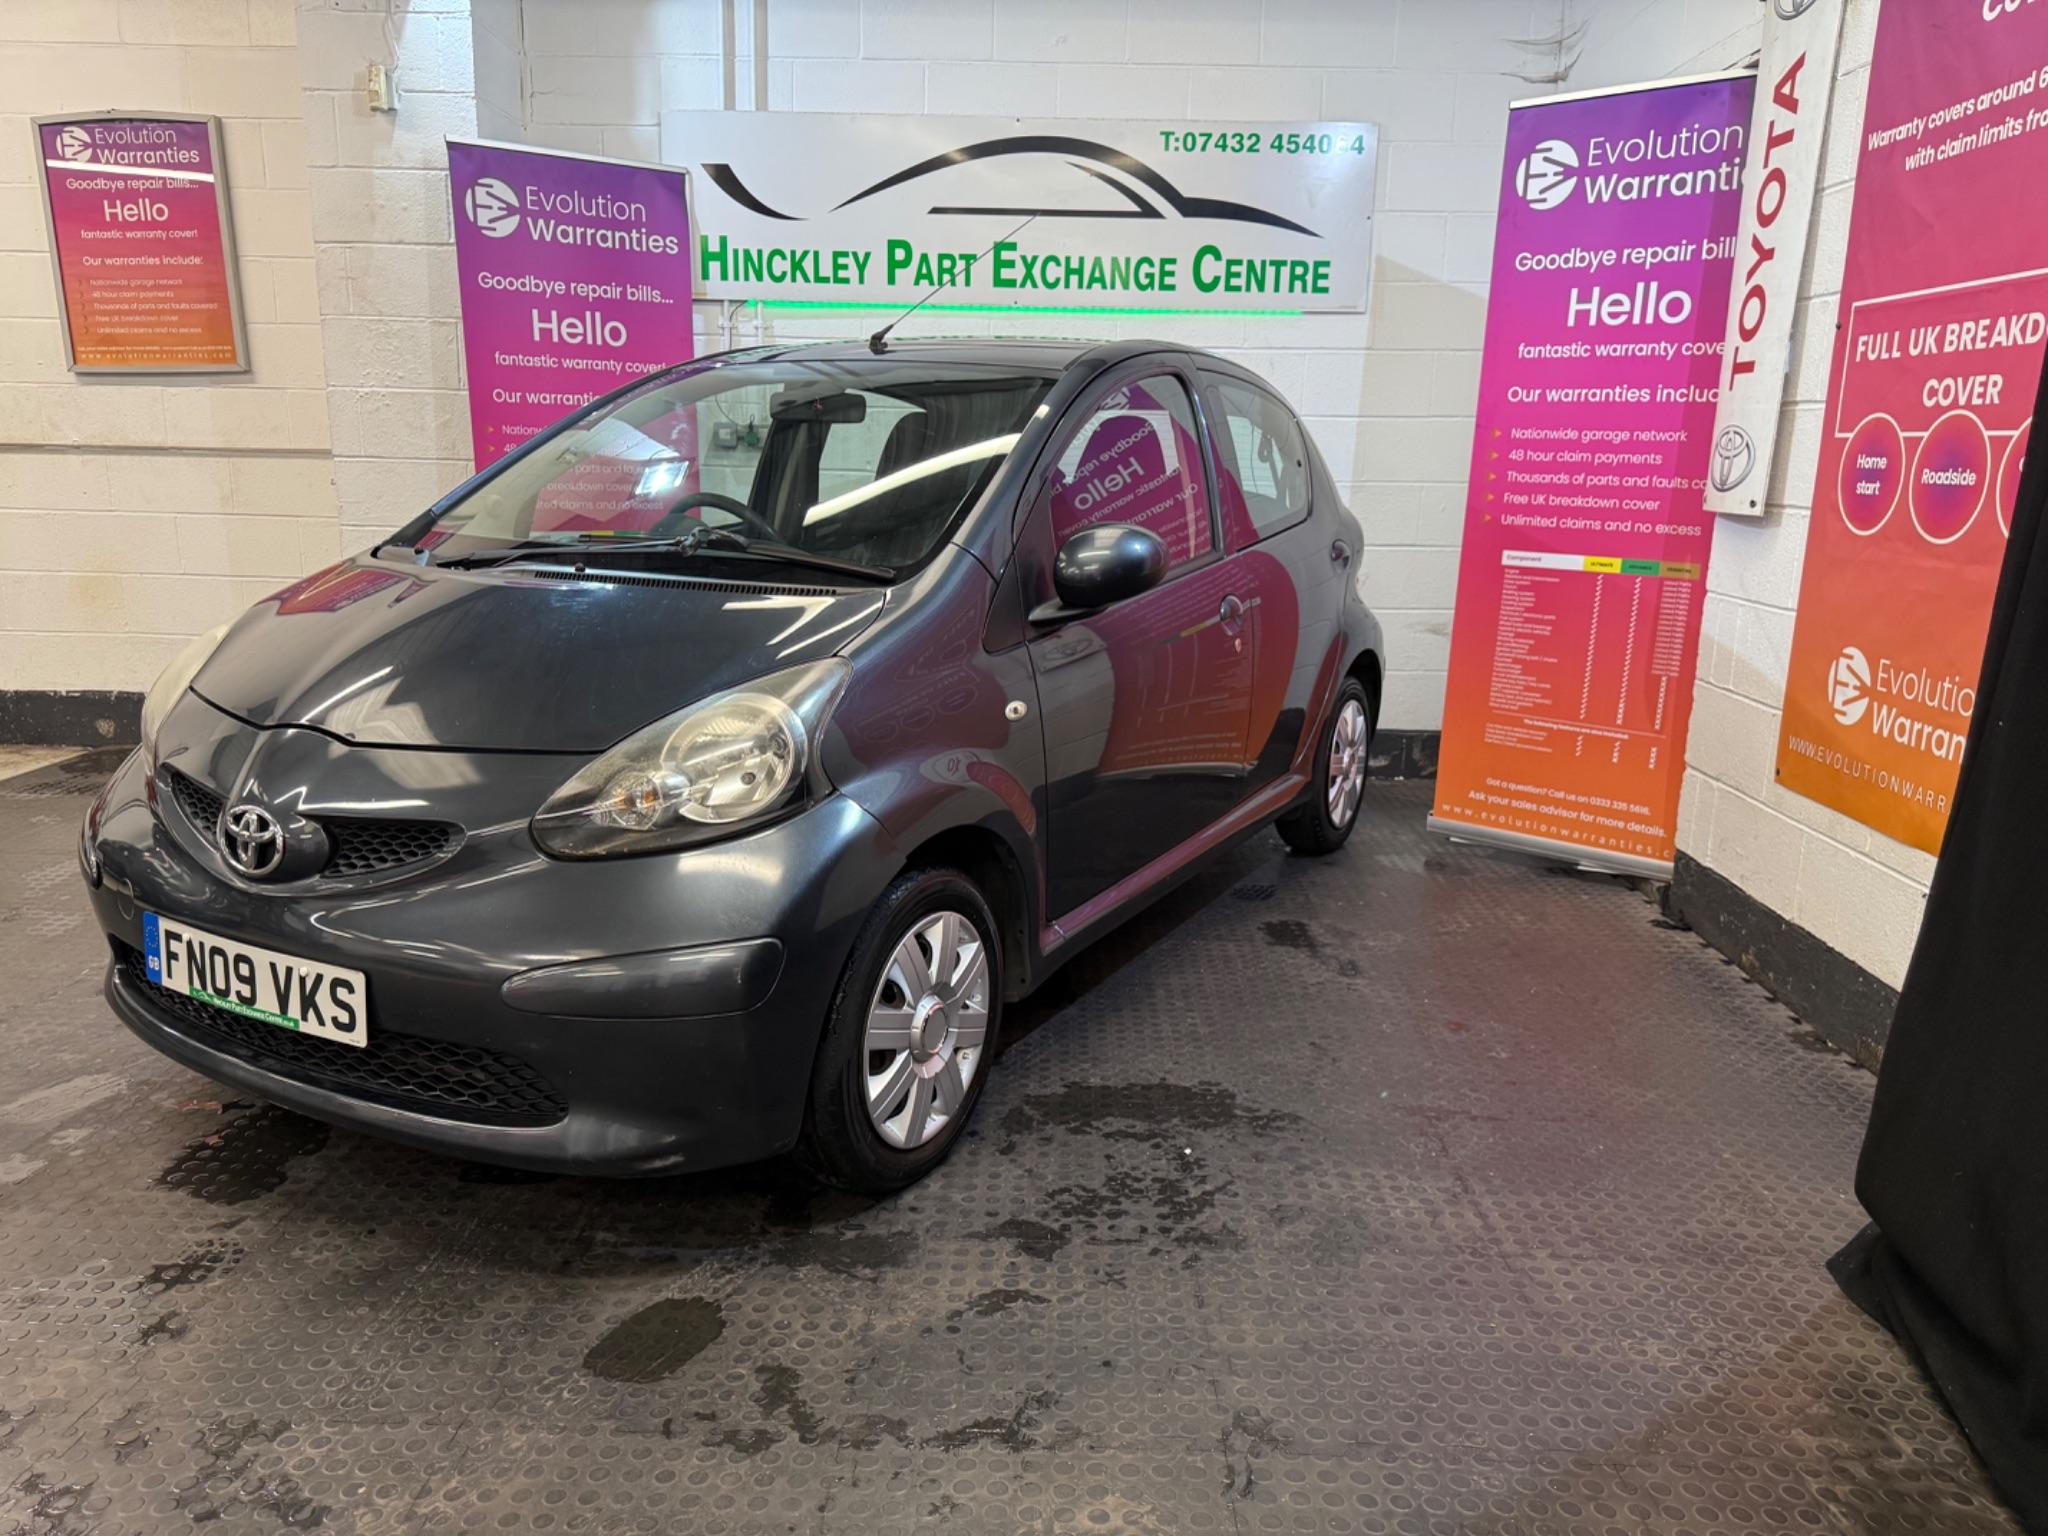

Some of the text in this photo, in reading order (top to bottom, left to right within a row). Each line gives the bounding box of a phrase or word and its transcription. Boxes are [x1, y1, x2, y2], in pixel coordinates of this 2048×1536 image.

[1868, 116, 1927, 151] Warranty
[1928, 98, 1975, 129] covers
[1976, 70, 2037, 111] around
[95, 128, 177, 144] Evolution
[1160, 131, 1261, 153] T:07432
[1588, 122, 1744, 167] Evolution
[1905, 145, 1936, 171] with
[1937, 133, 1977, 161] claim
[1978, 117, 2024, 148] limits
[97, 147, 200, 164] Warranties
[66, 178, 125, 192] Goodbye
[127, 178, 164, 192] repair
[1584, 157, 1742, 204] Warranti
[103, 198, 169, 222] Hello
[526, 186, 647, 222] Evolution
[1729, 51, 1806, 391] TOYOTA
[81, 229, 198, 240] fantastic warranty cover!
[526, 216, 680, 255] Warranties
[83, 256, 102, 265] Our
[104, 256, 161, 265] warranties
[700, 234, 1331, 294] HINCKLEY PART EXCHANGE CENTRE
[1515, 247, 1616, 273] Goodbye
[1622, 240, 1696, 270] repair
[478, 272, 674, 304] Goodbye repair bills...
[1567, 281, 1692, 327] Hello
[532, 308, 628, 347] Hello
[1855, 312, 2048, 362] FULL UK BREAKD
[1518, 341, 1591, 359] fantastic
[1595, 340, 1678, 361] warranty
[495, 351, 559, 368] fantastic
[561, 358, 623, 375] warranty
[492, 388, 522, 403] Our
[1507, 386, 1543, 403] Our
[1553, 384, 1651, 403] warranties
[1922, 374, 2003, 408] COVER
[1511, 427, 1688, 444] Nationwide garage network
[1508, 449, 1663, 467] 48 hour claim payments
[1856, 453, 1888, 470] Home
[1506, 471, 1570, 485] Thousands
[1572, 472, 1585, 485] of
[1586, 474, 1620, 488] parts
[1622, 474, 1649, 487] and
[1652, 475, 1689, 489] faults
[1855, 480, 1881, 496] start
[1921, 467, 1976, 487] Roadside
[1504, 492, 1661, 511] Free UK breakdown cover
[1501, 513, 1702, 536] Unlimited claims and no excess
[1789, 734, 1951, 814] WWW.EVOLUTIONWARR
[1468, 790, 1487, 801] Ask
[1487, 794, 1510, 805] your
[1511, 799, 1537, 811] sales
[1539, 804, 1578, 819] advisor
[1579, 811, 1595, 823] for
[1595, 815, 1625, 829] more
[148, 955, 160, 971] GB
[165, 929, 357, 1034] FN09 VKS
